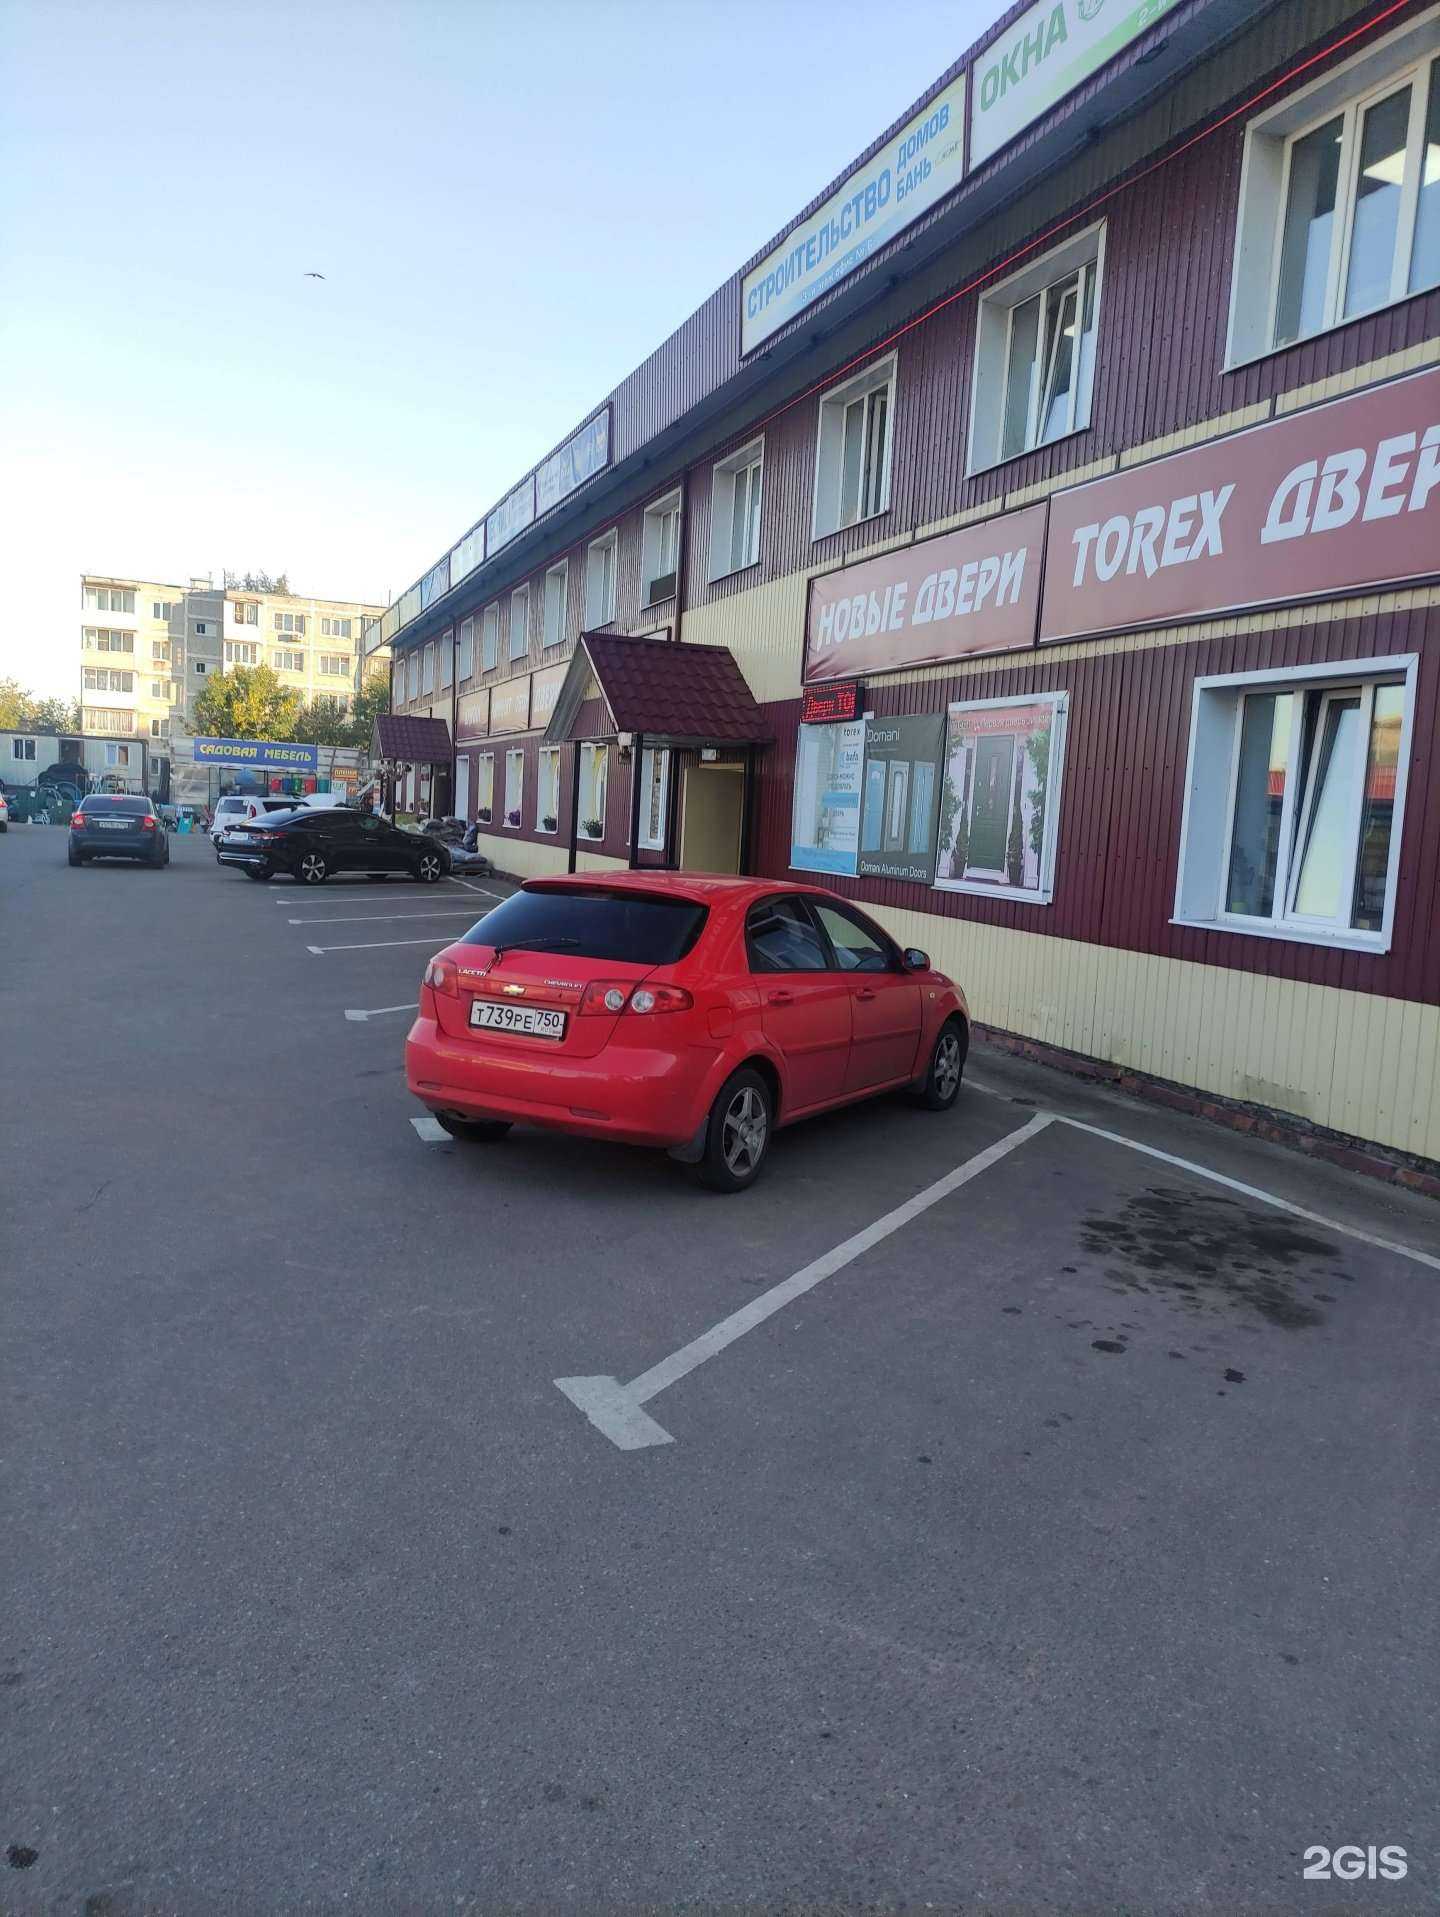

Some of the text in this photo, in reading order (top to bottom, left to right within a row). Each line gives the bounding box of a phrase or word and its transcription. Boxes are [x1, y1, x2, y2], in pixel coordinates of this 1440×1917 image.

[981, 3, 1068, 112] ОКНА
[896, 104, 950, 174] ДОМОВ
[897, 157, 932, 203] БАНЬ
[748, 168, 891, 319] СТРОИТЕЛЬСТВО
[1072, 483, 1237, 588] TOREX
[815, 547, 1027, 652] НОВЫЕ ДВЕРИ
[200, 743, 312, 762] САДОВАЯ МЕБЕЛЬ
[867, 727, 900, 743] Domani
[880, 863, 909, 877] Aluminum
[909, 865, 927, 879] Doors
[537, 1011, 560, 1028] 750
